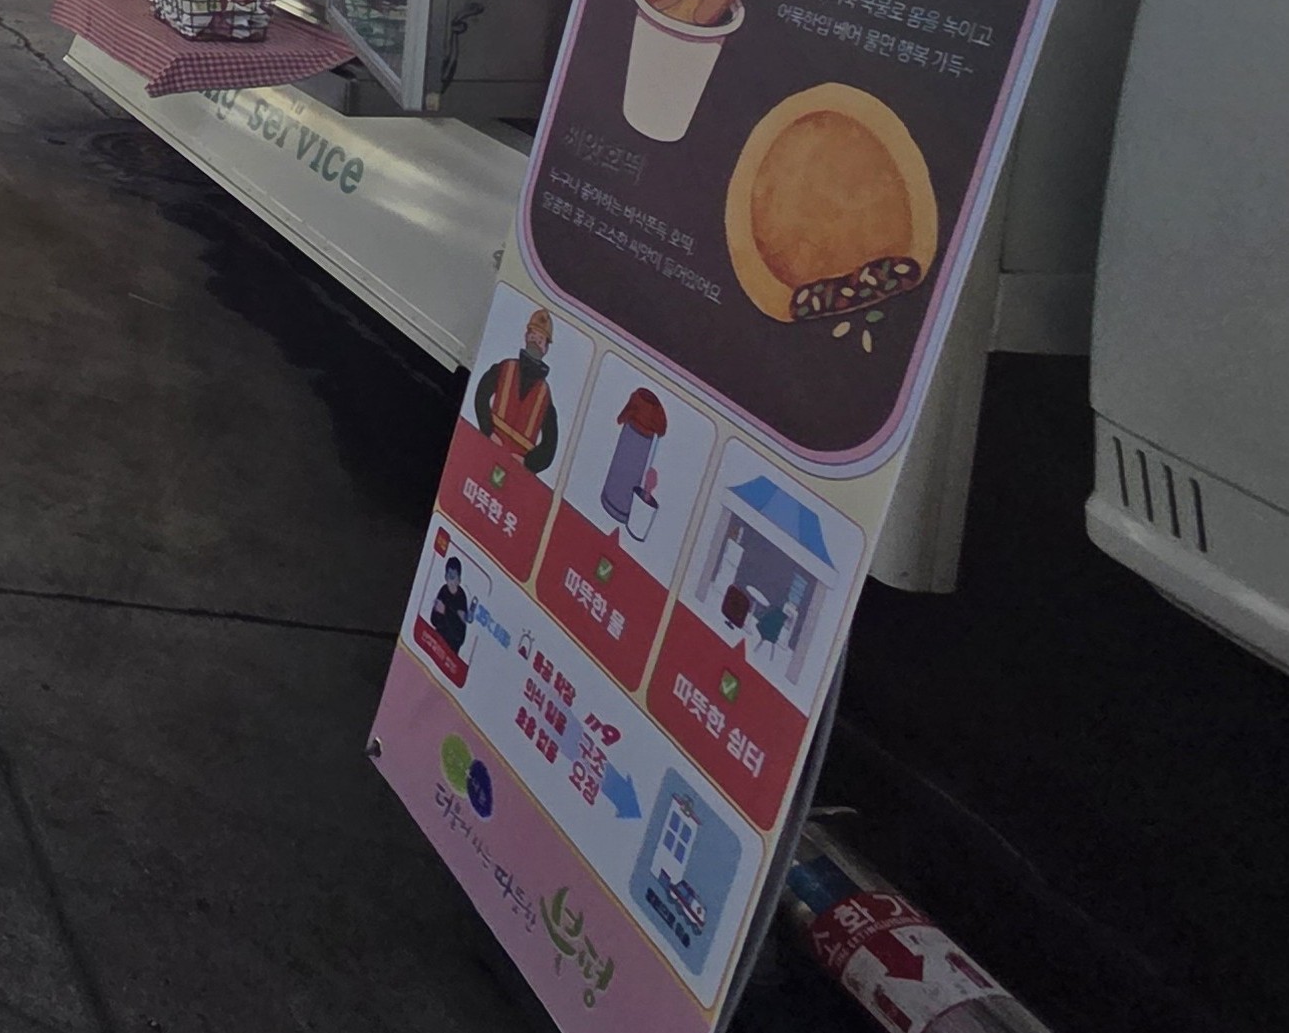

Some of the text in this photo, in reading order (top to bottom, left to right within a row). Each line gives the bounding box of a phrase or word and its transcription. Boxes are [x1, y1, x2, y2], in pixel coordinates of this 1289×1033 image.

[863, 28, 897, 58] 물면
[897, 39, 930, 68] 행복
[907, 6, 941, 34] 몸을
[942, 15, 994, 47] 녹이고
[246, 98, 365, 194] service
[549, 168, 581, 195] 누구나
[581, 182, 624, 218] 좋아하는
[463, 476, 519, 539] 따뜻한 옷
[563, 566, 626, 642] 따뜻한 물
[584, 711, 622, 747] 119
[672, 672, 766, 779] 따뜻한 쉼터
[578, 731, 609, 779] 구조
